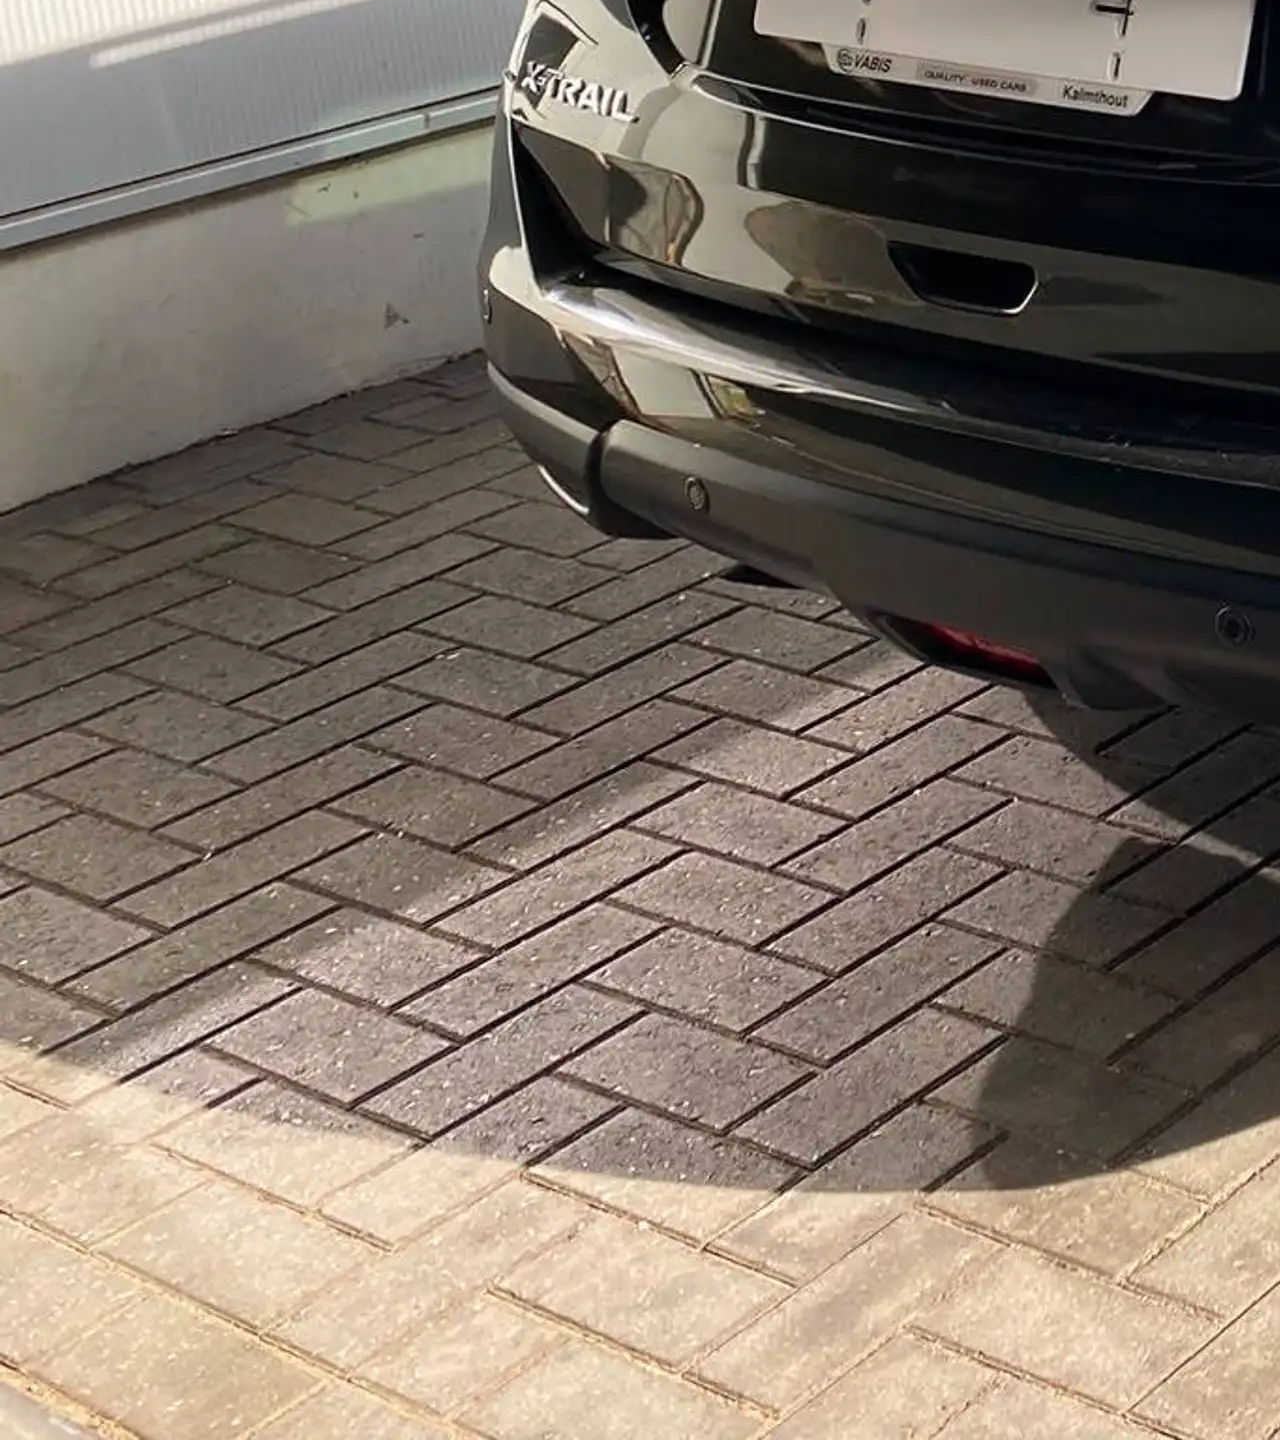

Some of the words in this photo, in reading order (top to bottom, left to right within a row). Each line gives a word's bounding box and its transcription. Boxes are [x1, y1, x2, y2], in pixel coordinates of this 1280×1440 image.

[855, 54, 892, 73] VABIS
[521, 60, 638, 123] X-TRAIL
[1063, 84, 1128, 108] Kalmthout
